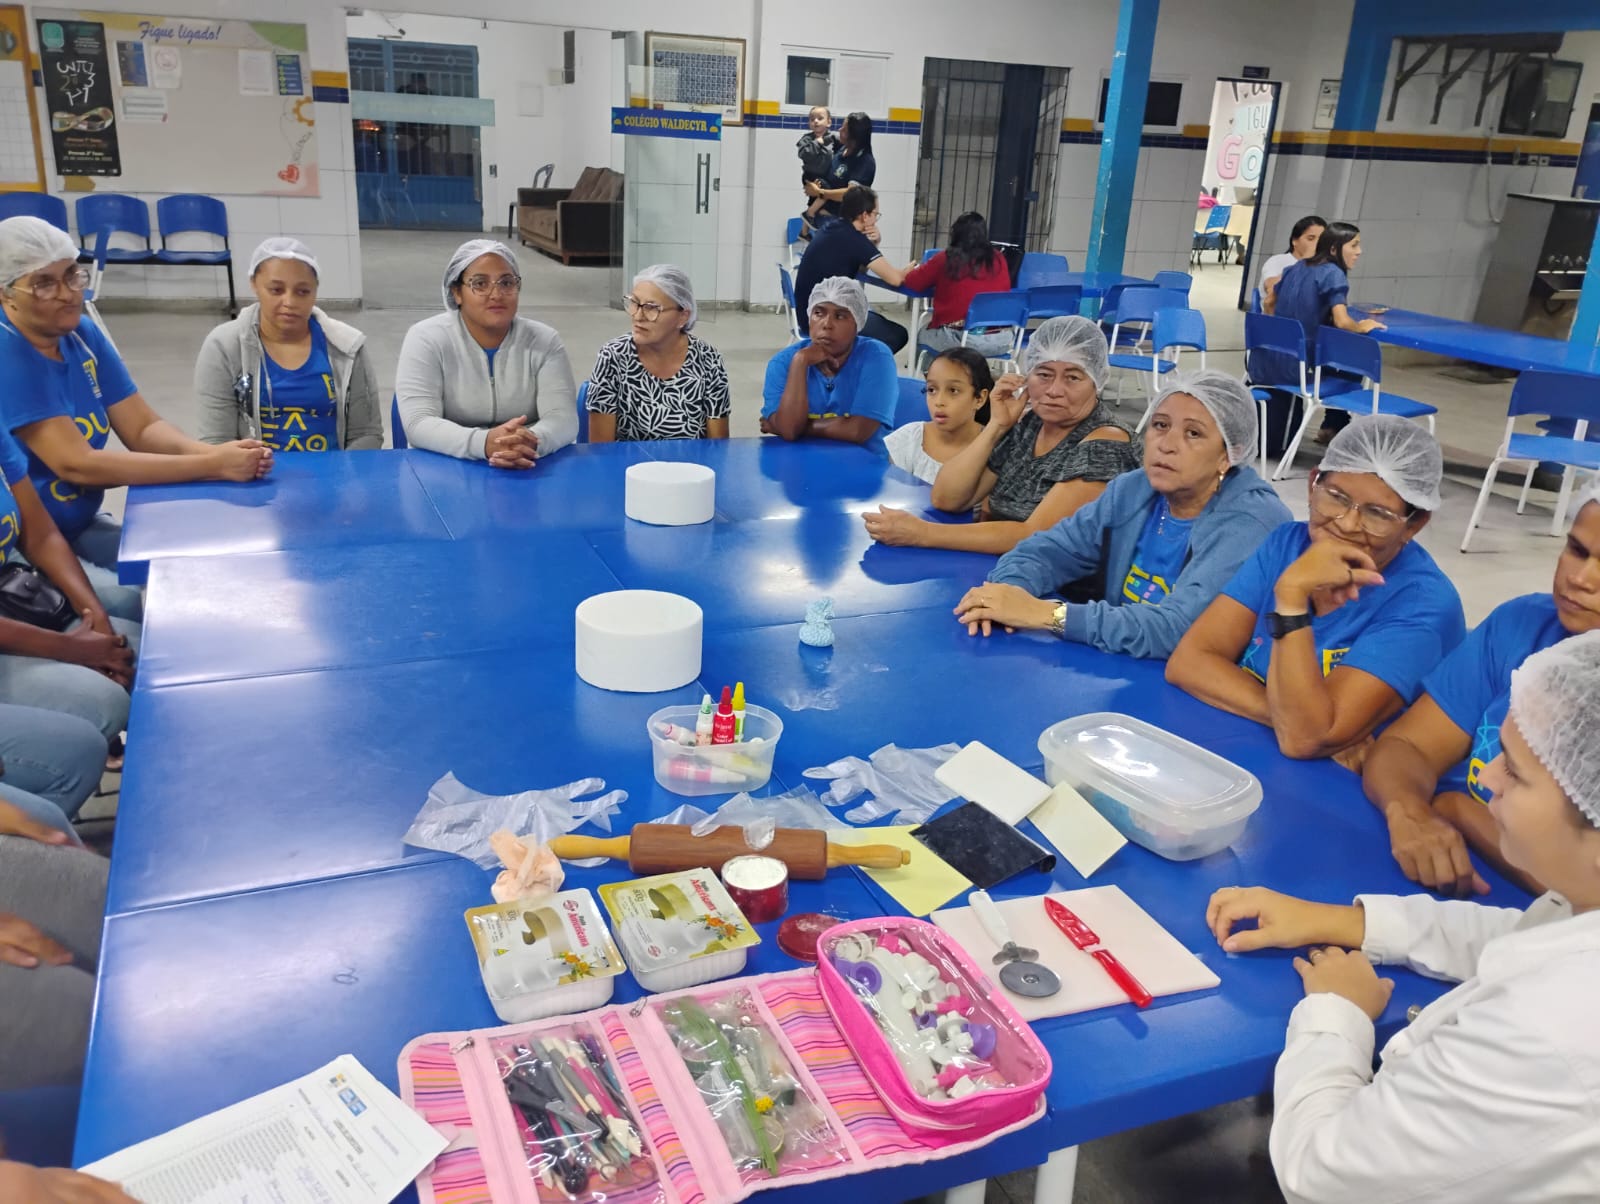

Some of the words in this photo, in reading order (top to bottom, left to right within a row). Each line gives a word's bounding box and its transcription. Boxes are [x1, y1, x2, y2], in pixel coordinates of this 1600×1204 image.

[138, 21, 174, 42] Fique
[178, 25, 222, 44] ligado!
[624, 113, 659, 129] COLÉGIO
[661, 118, 707, 132] WALDECYR
